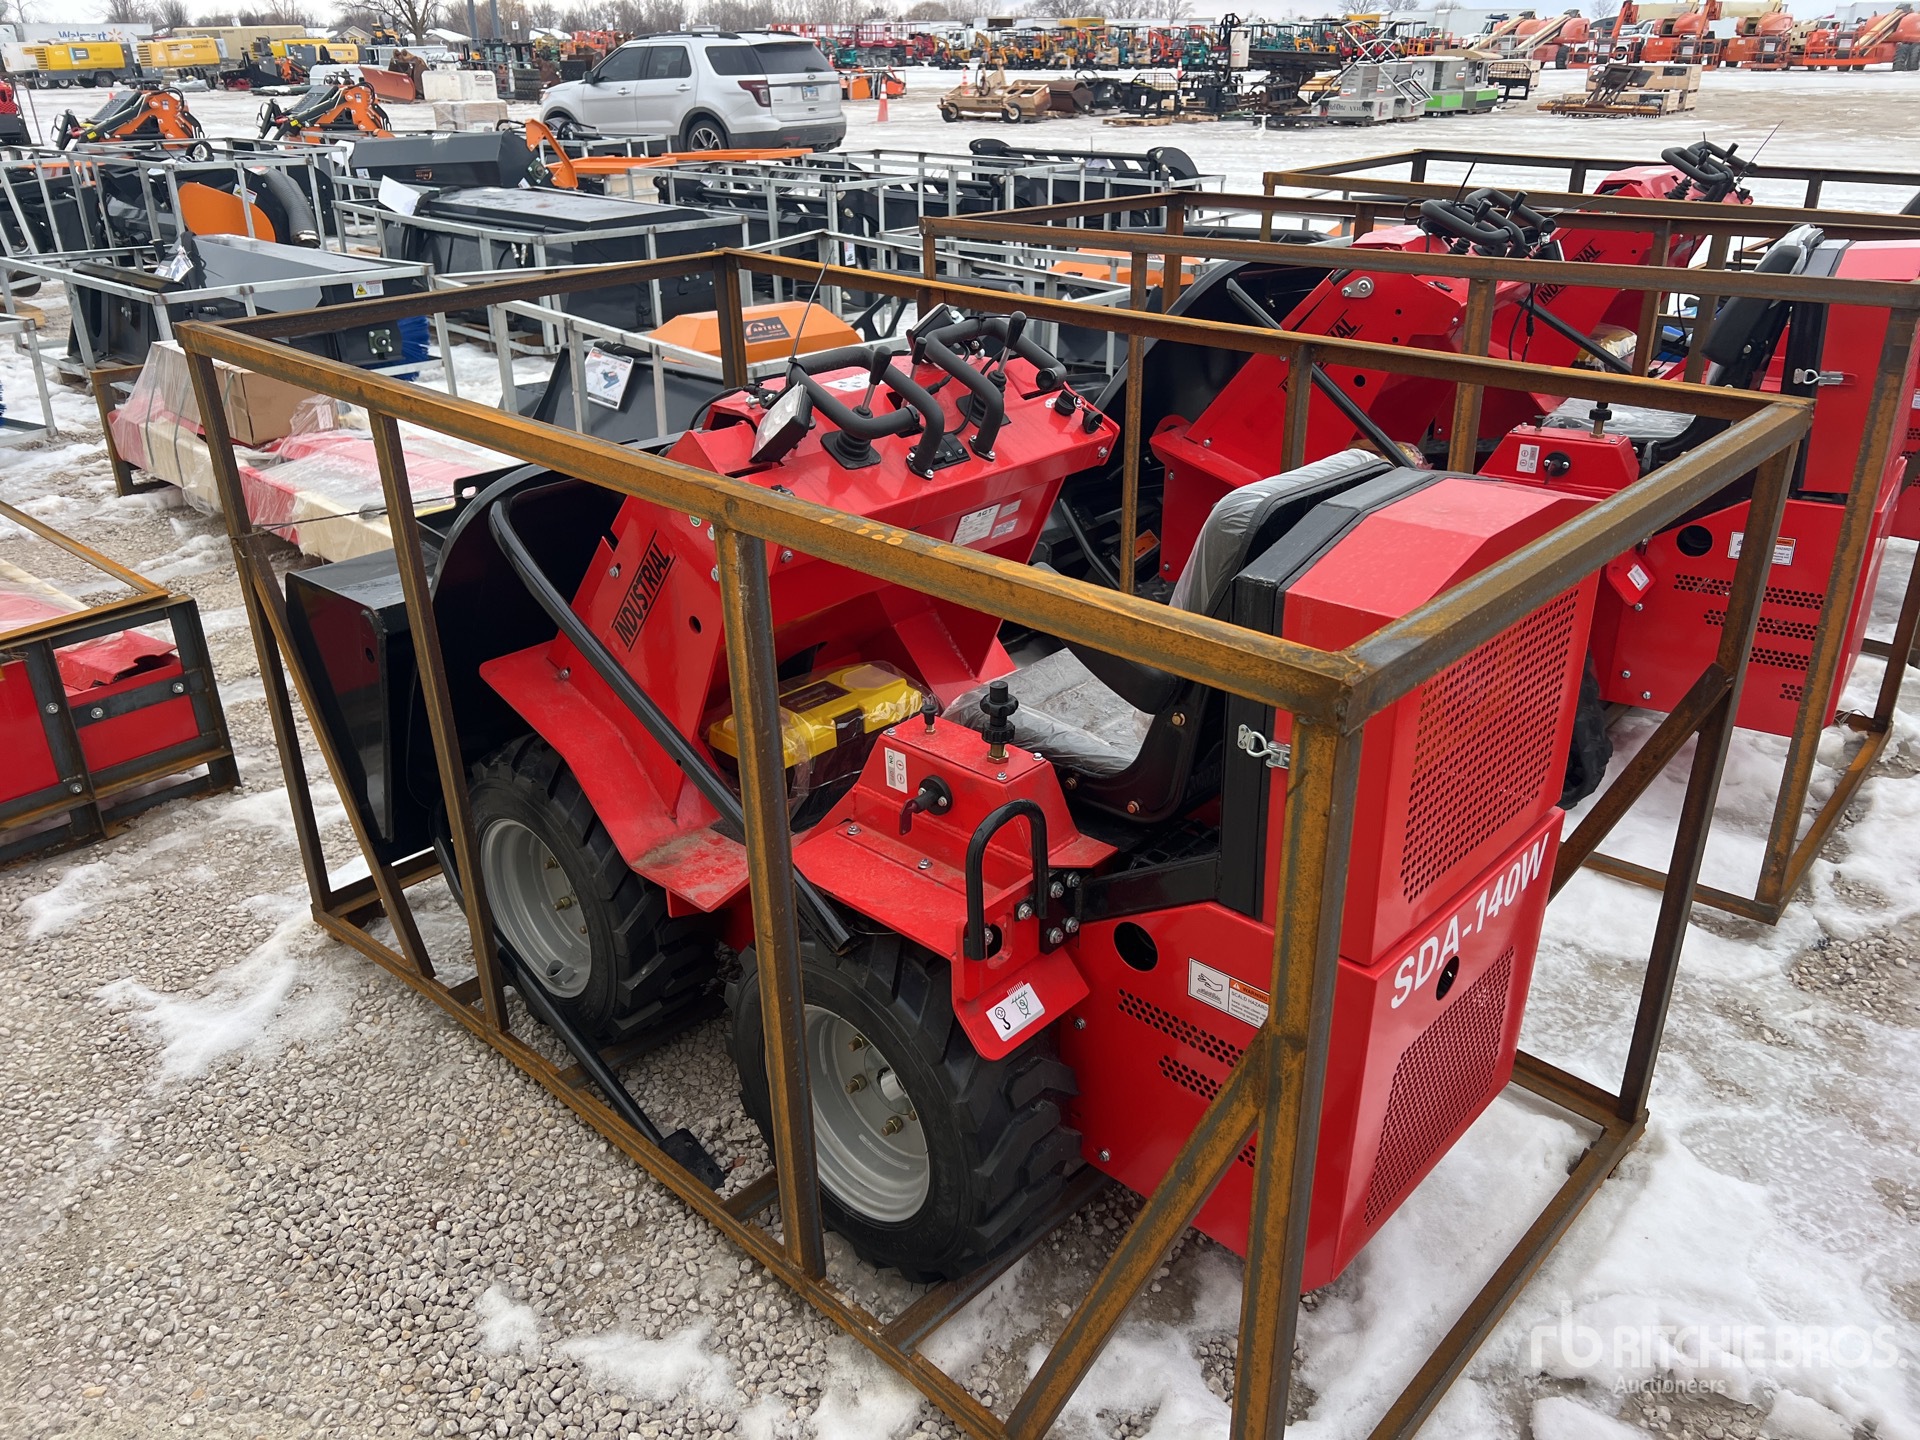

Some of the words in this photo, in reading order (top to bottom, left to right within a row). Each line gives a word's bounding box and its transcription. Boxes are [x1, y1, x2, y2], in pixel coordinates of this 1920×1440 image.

[58, 31, 107, 41] Walmart
[976, 508, 994, 518] AGT
[614, 542, 671, 648] INDUSTRIAL
[1390, 831, 1550, 1010] SDA-140W
[1231, 991, 1248, 1002] SCALD
[1247, 997, 1268, 1012] HAZARD
[1242, 986, 1268, 1002] WARNING
